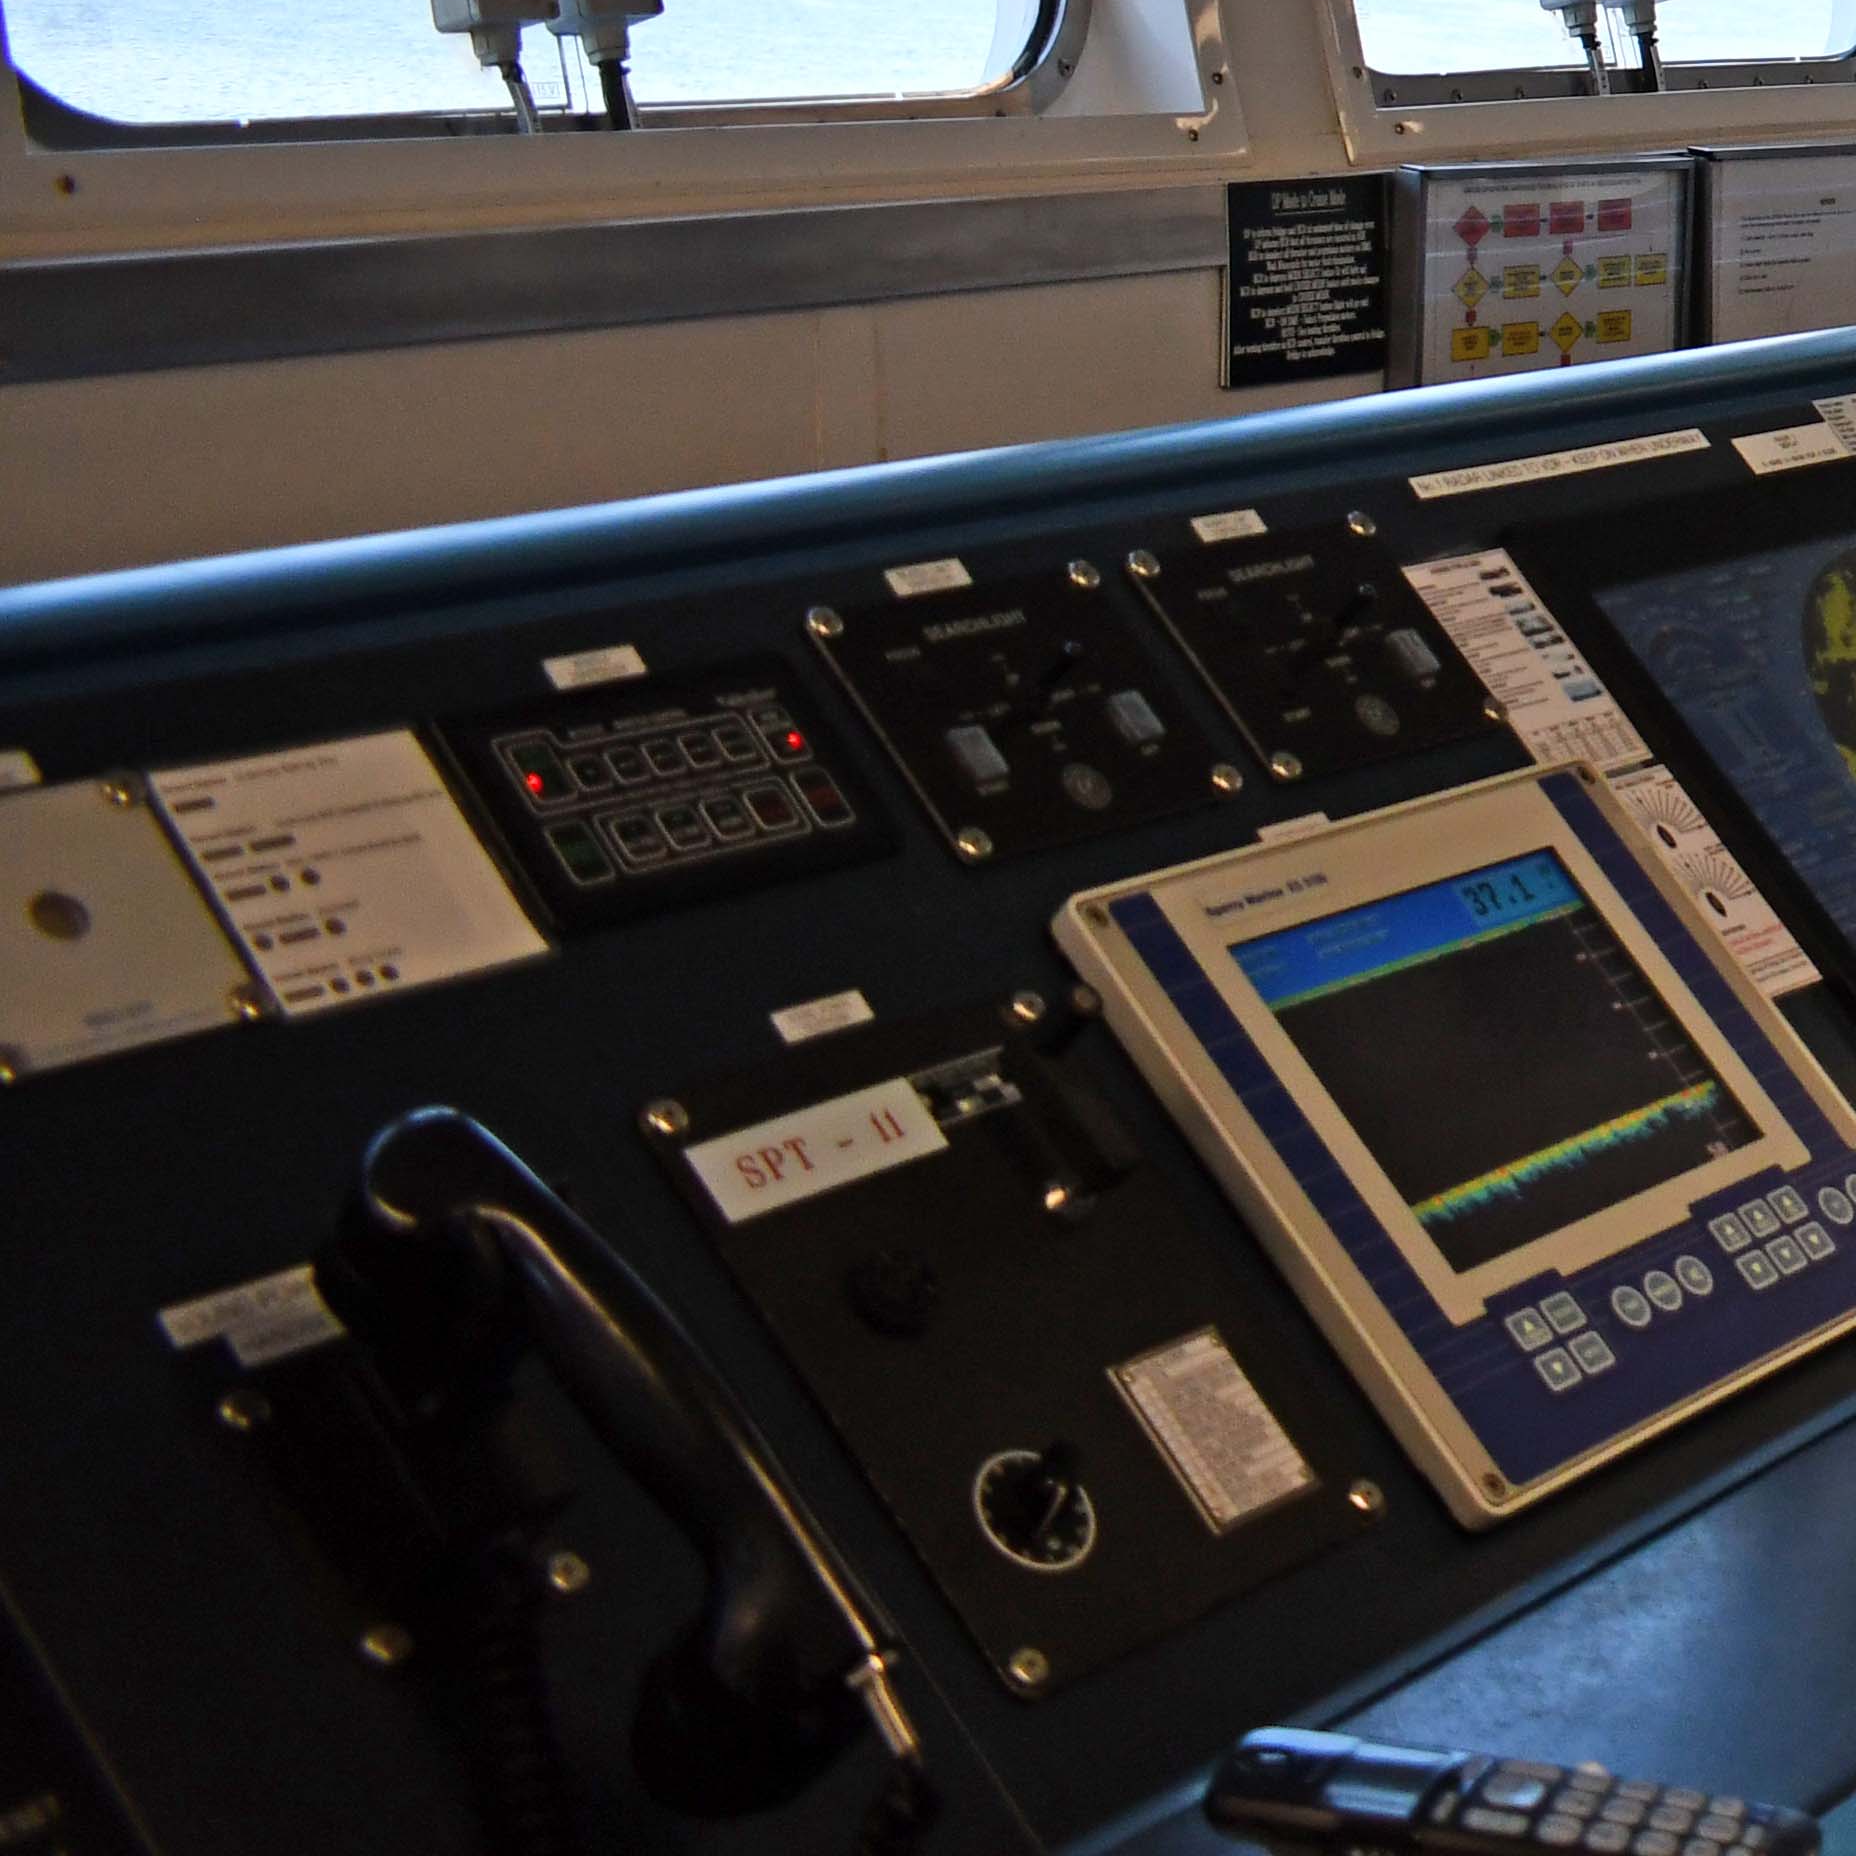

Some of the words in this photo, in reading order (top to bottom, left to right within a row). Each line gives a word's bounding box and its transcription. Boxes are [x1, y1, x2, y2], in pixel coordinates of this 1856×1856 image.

[1227, 553, 1314, 583] SEARCHLIGHT
[921, 608, 1026, 641] SEARCHLIGHT
[1463, 874, 1535, 916] 37.1
[736, 1135, 815, 1189] SPT
